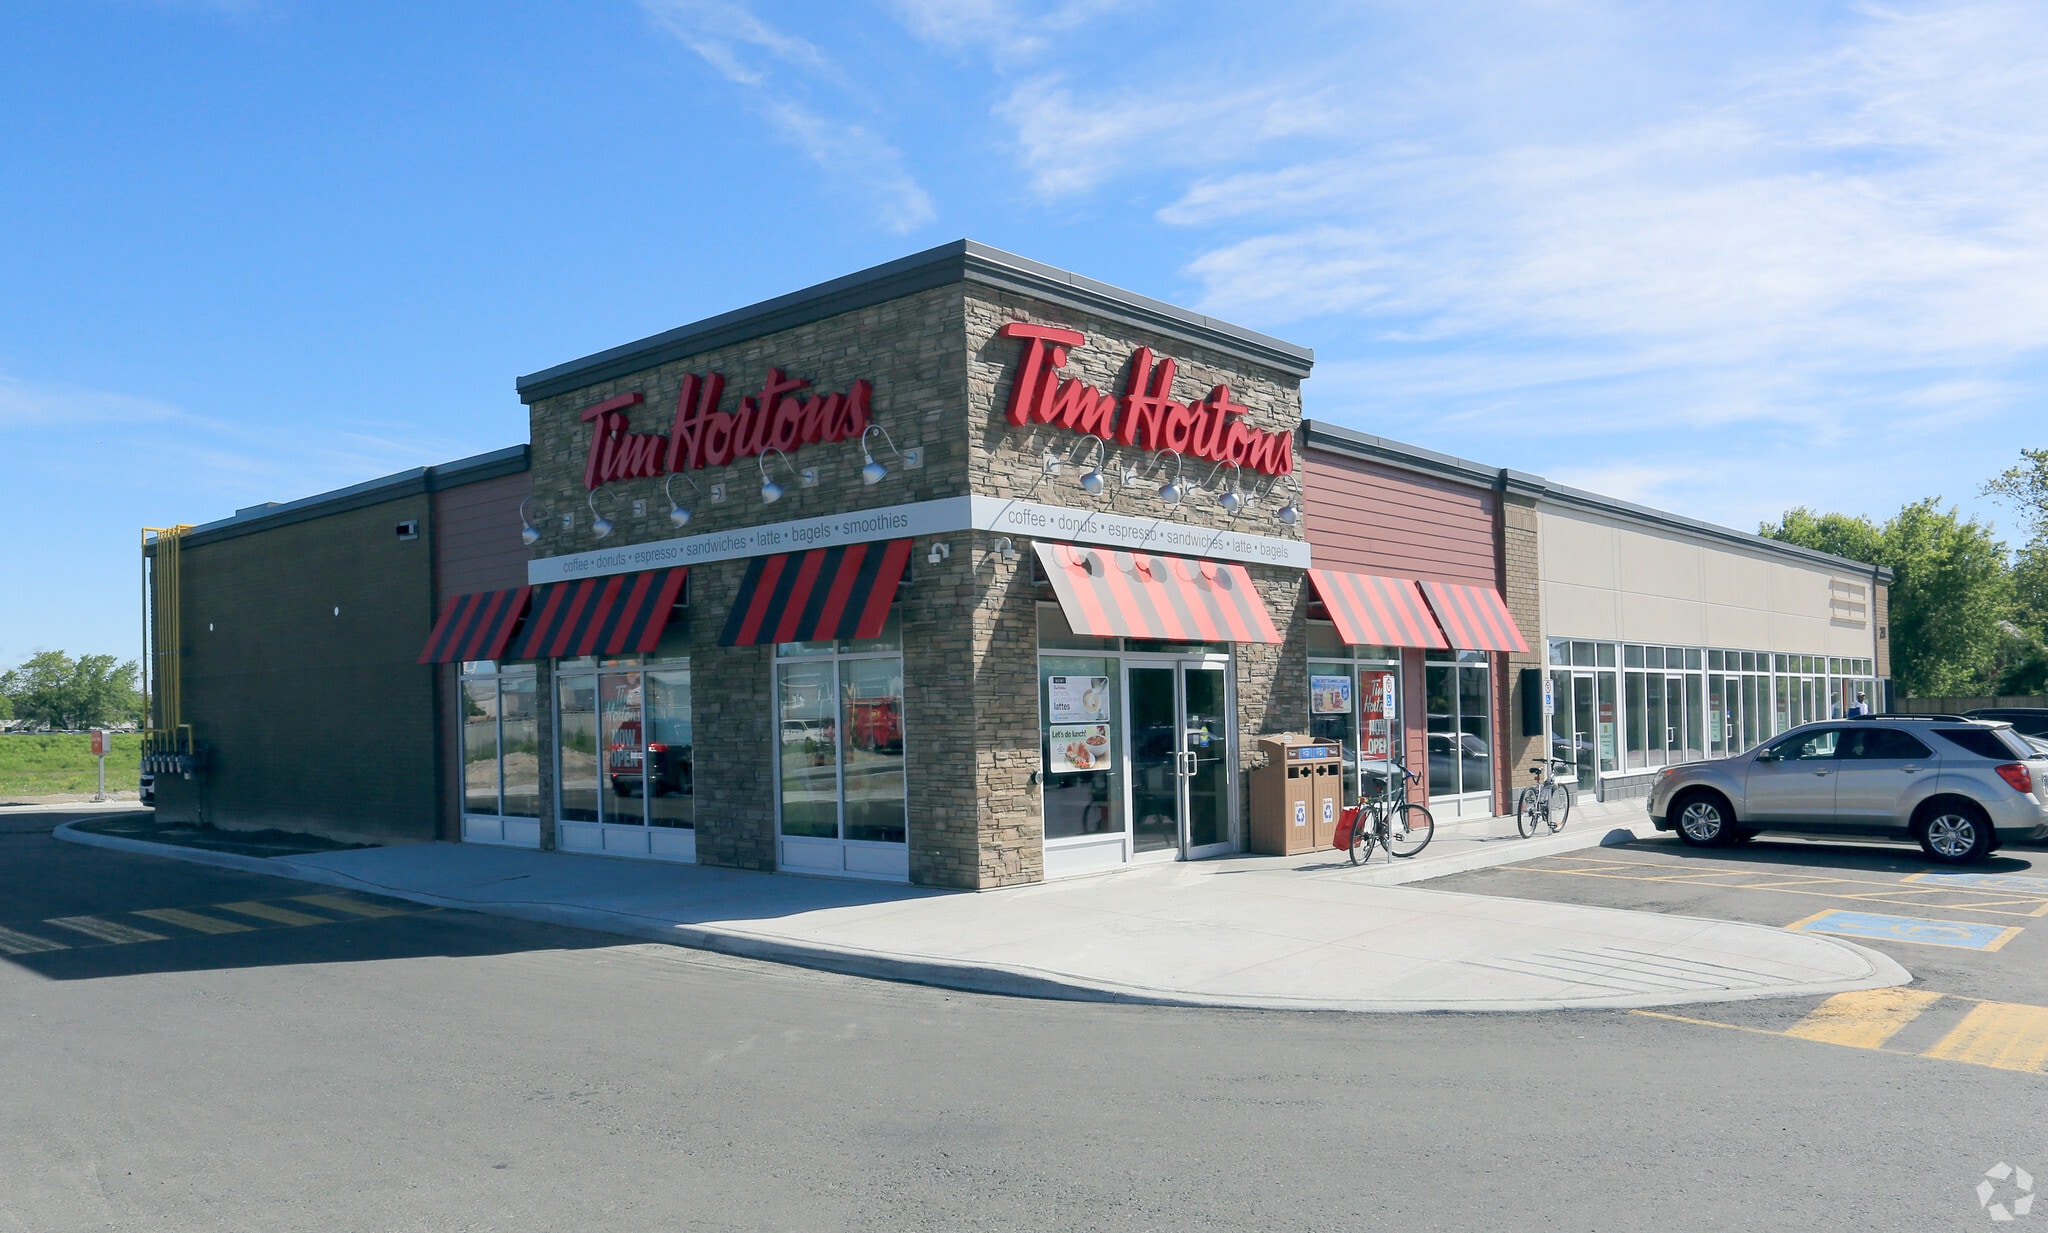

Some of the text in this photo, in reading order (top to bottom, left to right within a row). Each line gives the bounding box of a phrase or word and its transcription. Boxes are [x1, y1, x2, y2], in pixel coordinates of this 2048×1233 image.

[1000, 322, 1294, 477] Tim Hortons
[580, 367, 872, 490] Tim Hortons
[563, 512, 908, 573] coffee donuts espresso sandwiches latte bagels smoothies
[1008, 509, 1289, 560] coffee donuts espresso sandwiches latte bagels
[1053, 702, 1071, 711] lattes
[611, 729, 635, 747] NOW
[1052, 729, 1087, 738] Let's do lunch!
[611, 749, 638, 768] OPEN
